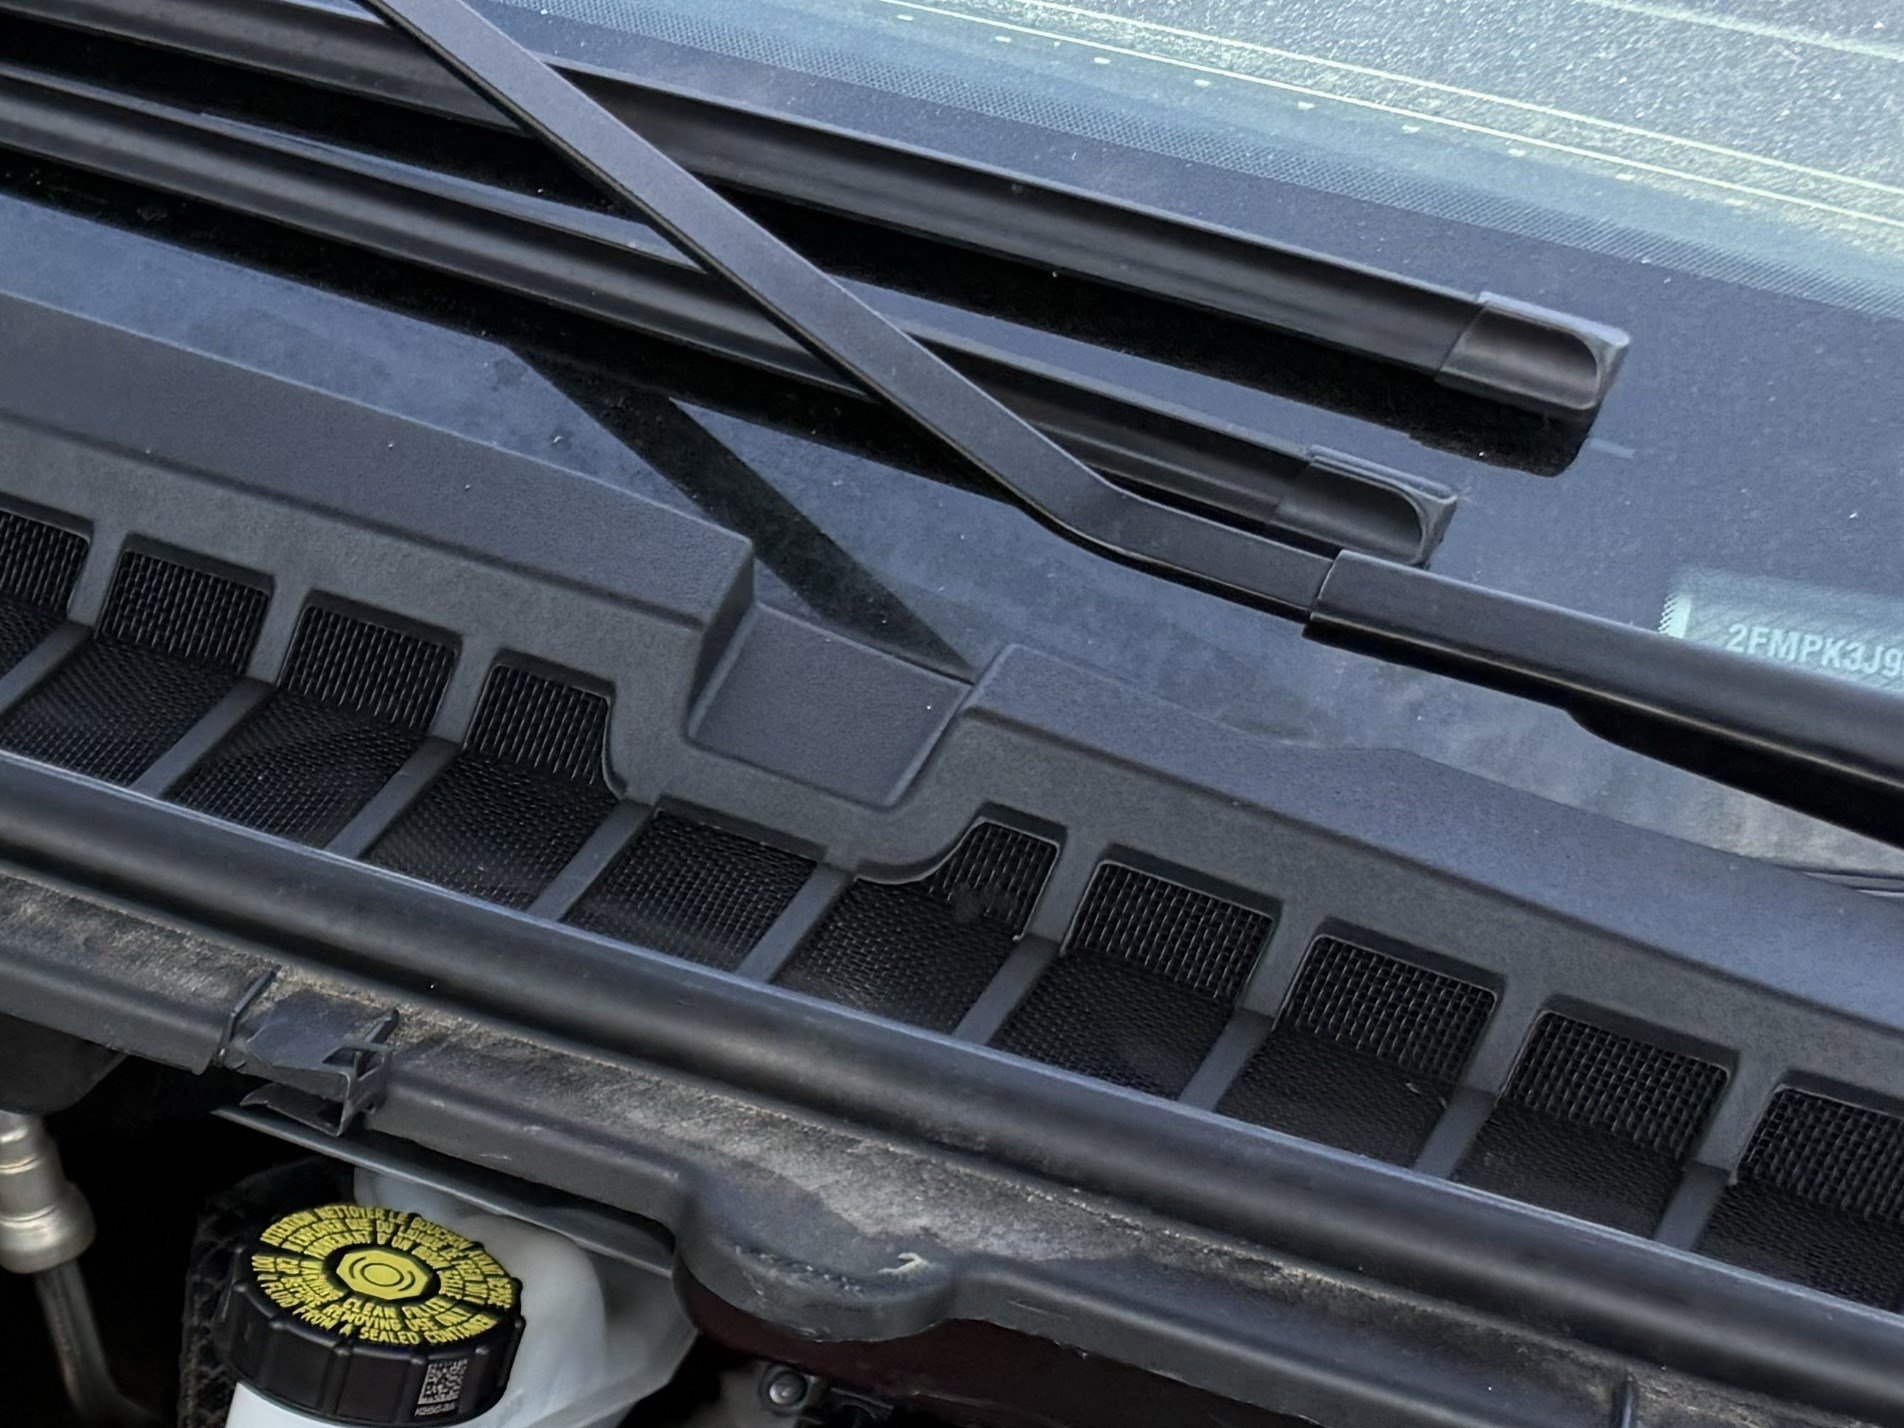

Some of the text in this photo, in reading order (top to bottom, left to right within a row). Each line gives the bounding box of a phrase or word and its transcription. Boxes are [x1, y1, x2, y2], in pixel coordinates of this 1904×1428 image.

[1725, 622, 1903, 682] 2FMPK3J9
[292, 1305, 339, 1331] FROM
[358, 1326, 420, 1345] SEALED
